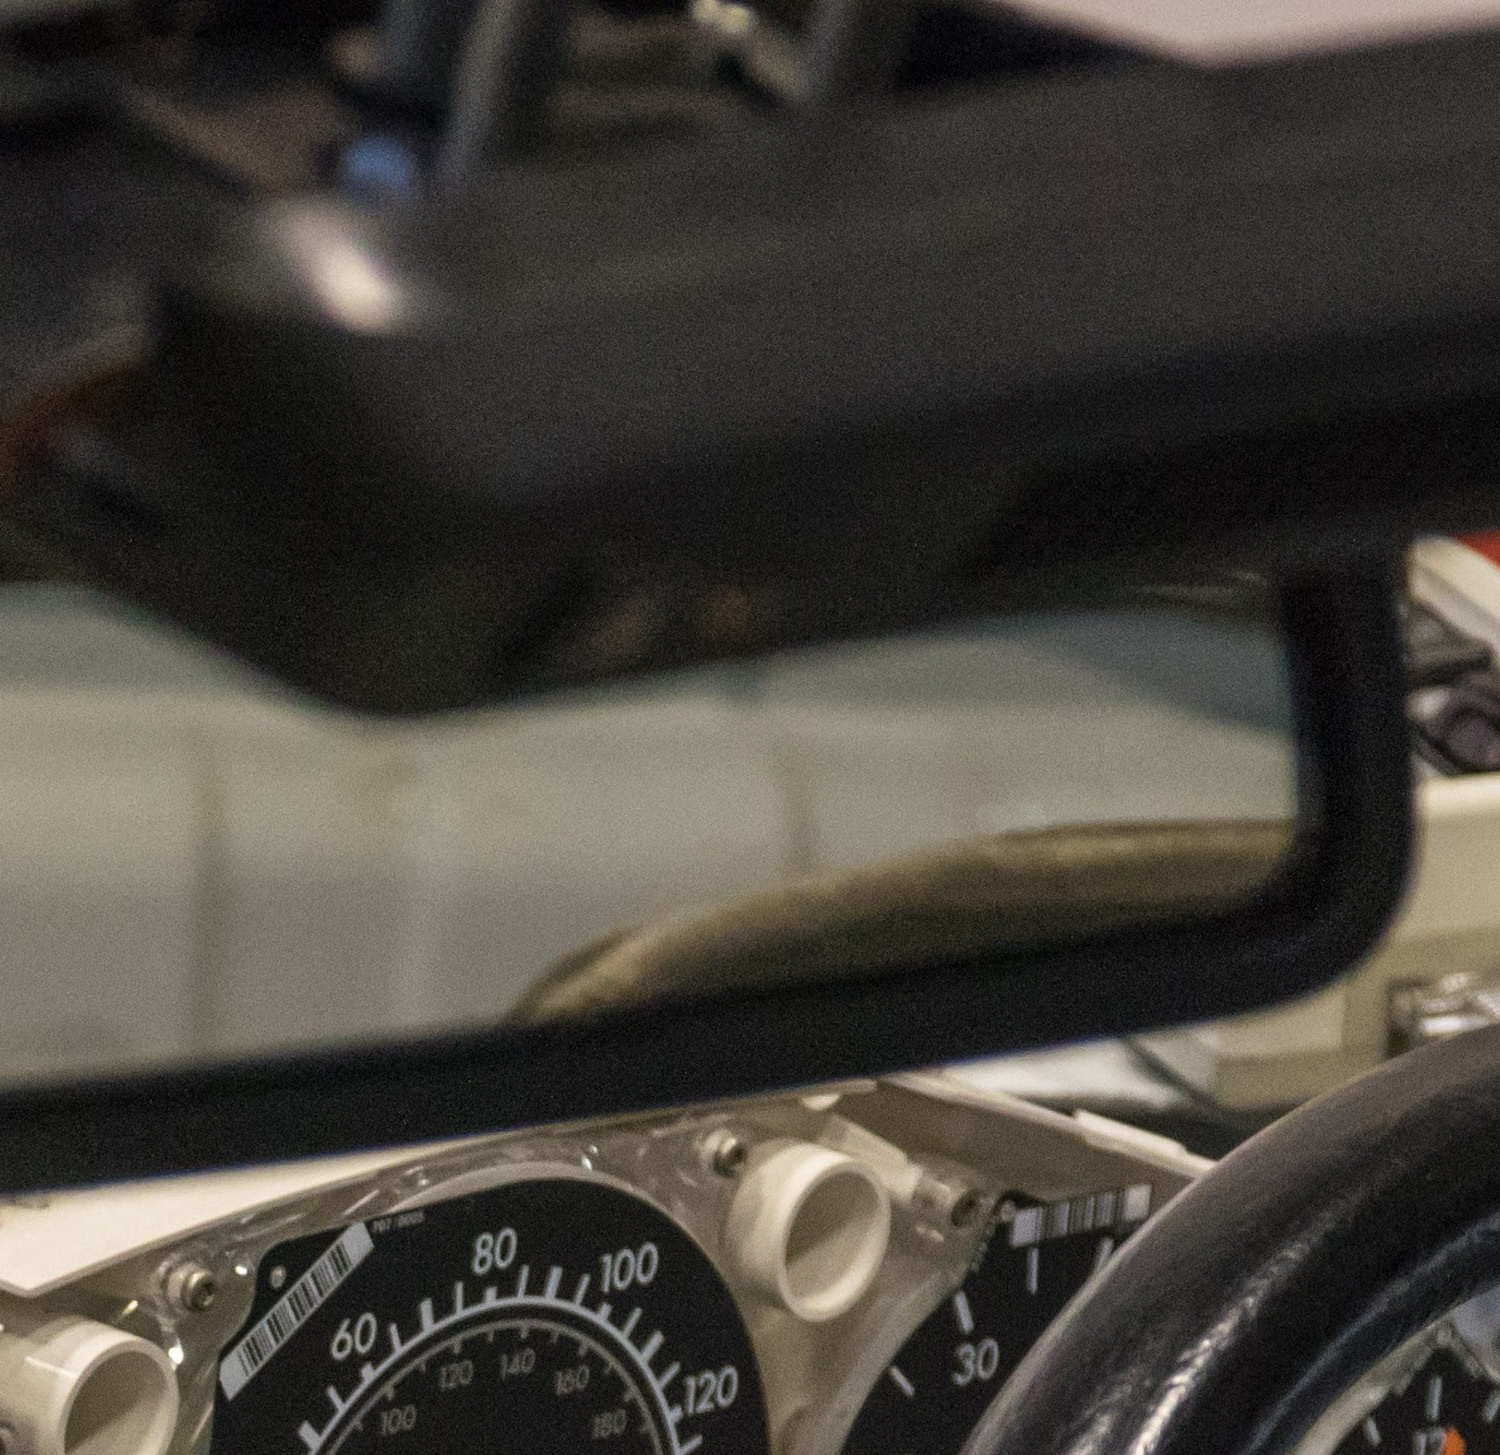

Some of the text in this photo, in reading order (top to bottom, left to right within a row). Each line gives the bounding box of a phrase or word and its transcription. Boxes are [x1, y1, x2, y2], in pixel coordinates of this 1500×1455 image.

[471, 1227, 518, 1274] 80
[601, 1242, 658, 1294] 100
[330, 1312, 378, 1361] 60
[440, 1359, 474, 1390] 120
[502, 1349, 536, 1380] 140
[556, 1366, 590, 1397] 160
[952, 1338, 1000, 1386] 30
[686, 1365, 739, 1416] 120
[381, 1405, 416, 1435] 100
